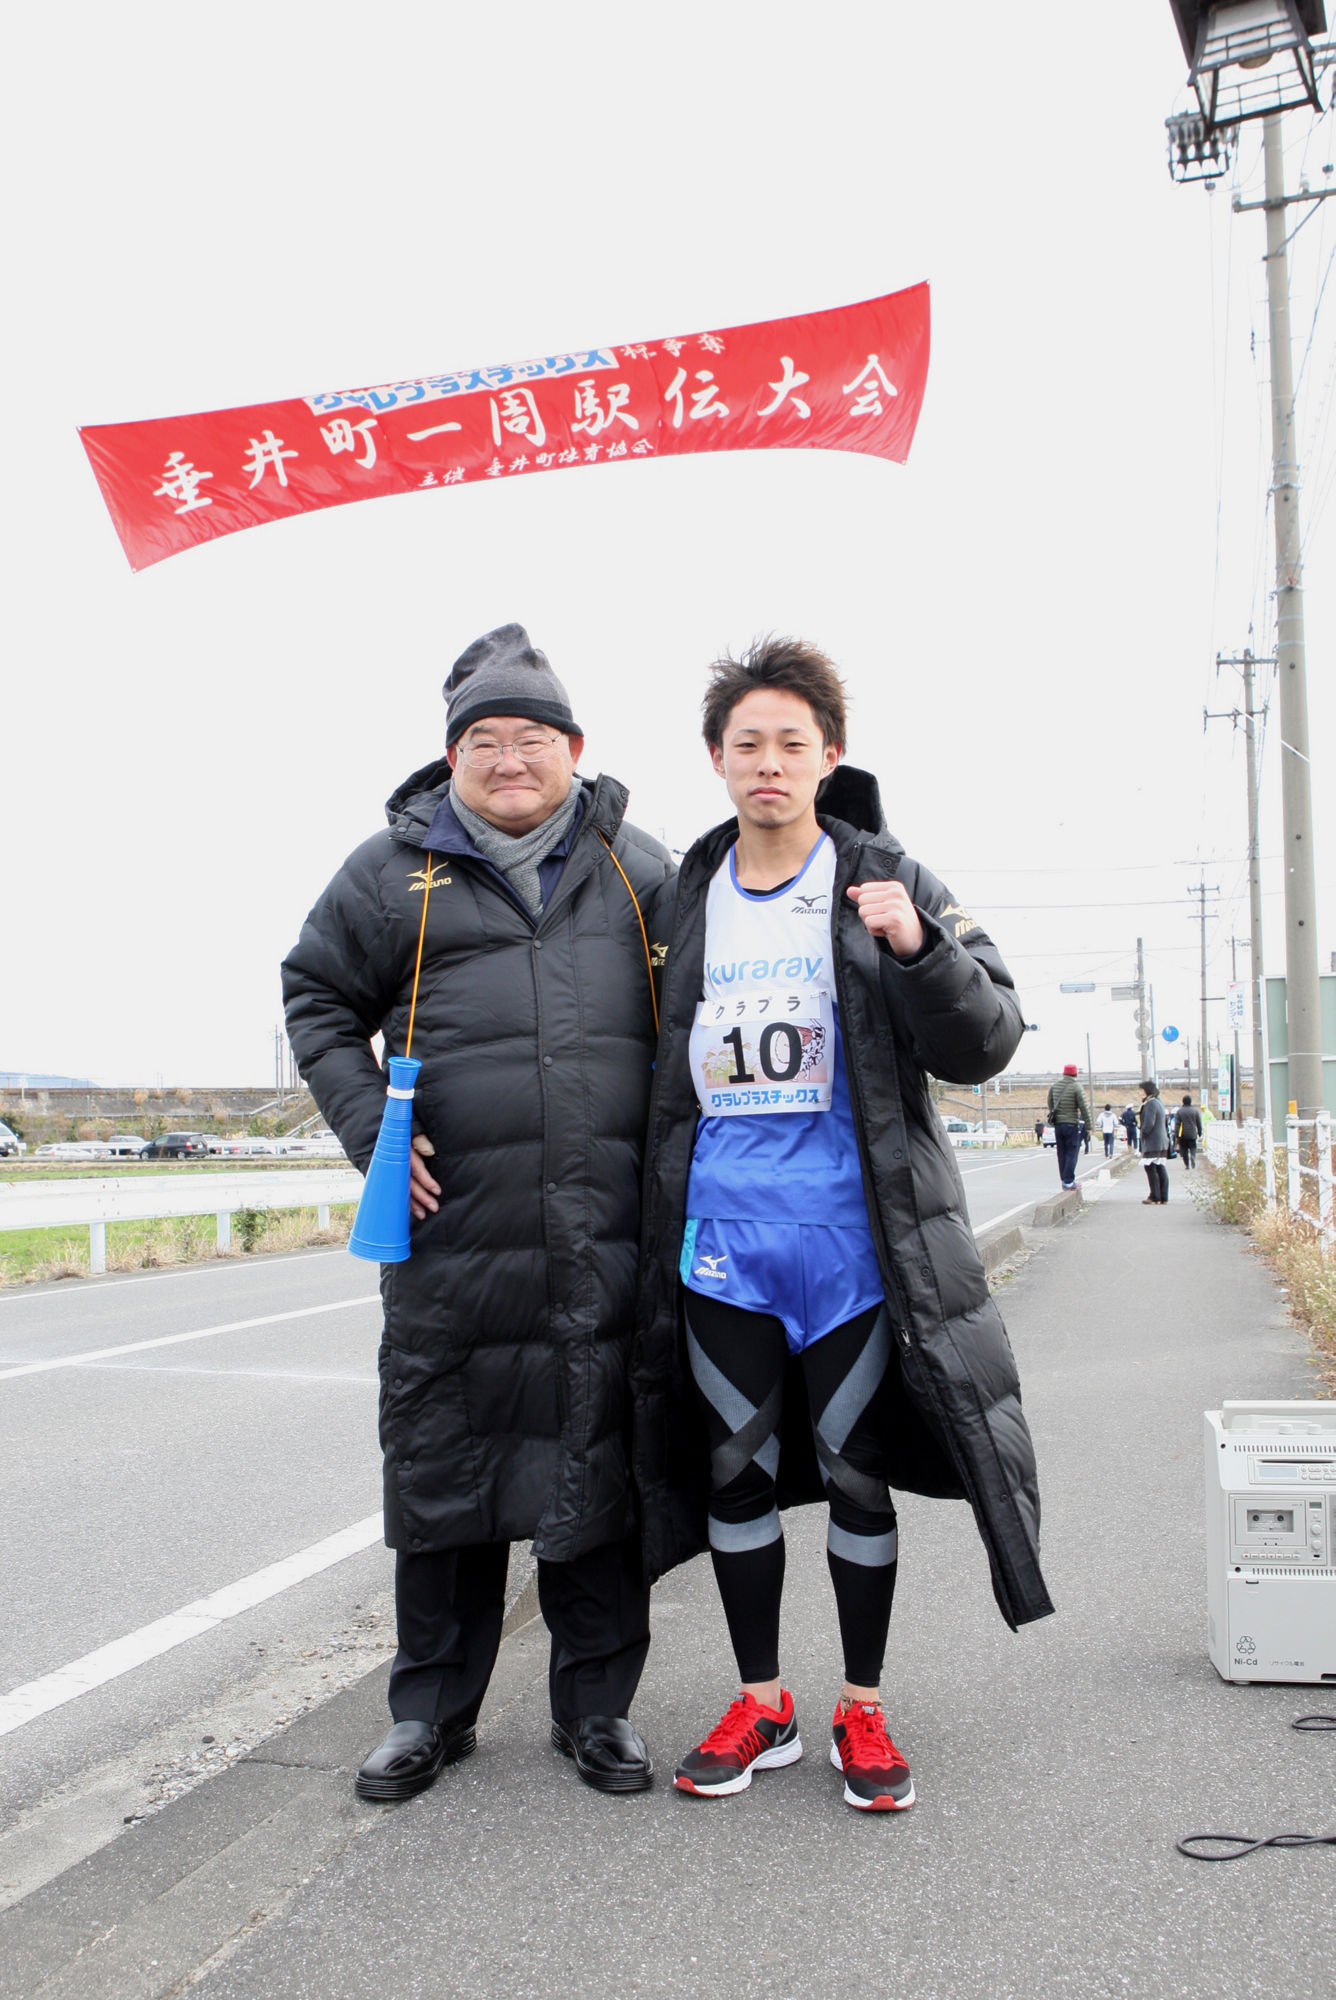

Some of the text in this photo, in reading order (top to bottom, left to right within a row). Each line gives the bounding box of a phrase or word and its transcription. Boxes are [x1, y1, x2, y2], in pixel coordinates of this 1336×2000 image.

[152, 353, 898, 515] 垂井町一周駅伝大会
[791, 905, 828, 915] MIZUNO
[706, 957, 824, 985] kuraray
[715, 996, 801, 1019] クラプラ
[722, 1021, 804, 1084] 10
[711, 1088, 819, 1109] クラレプラスチックス
[1234, 1657, 1258, 1666] Ni-Cd
